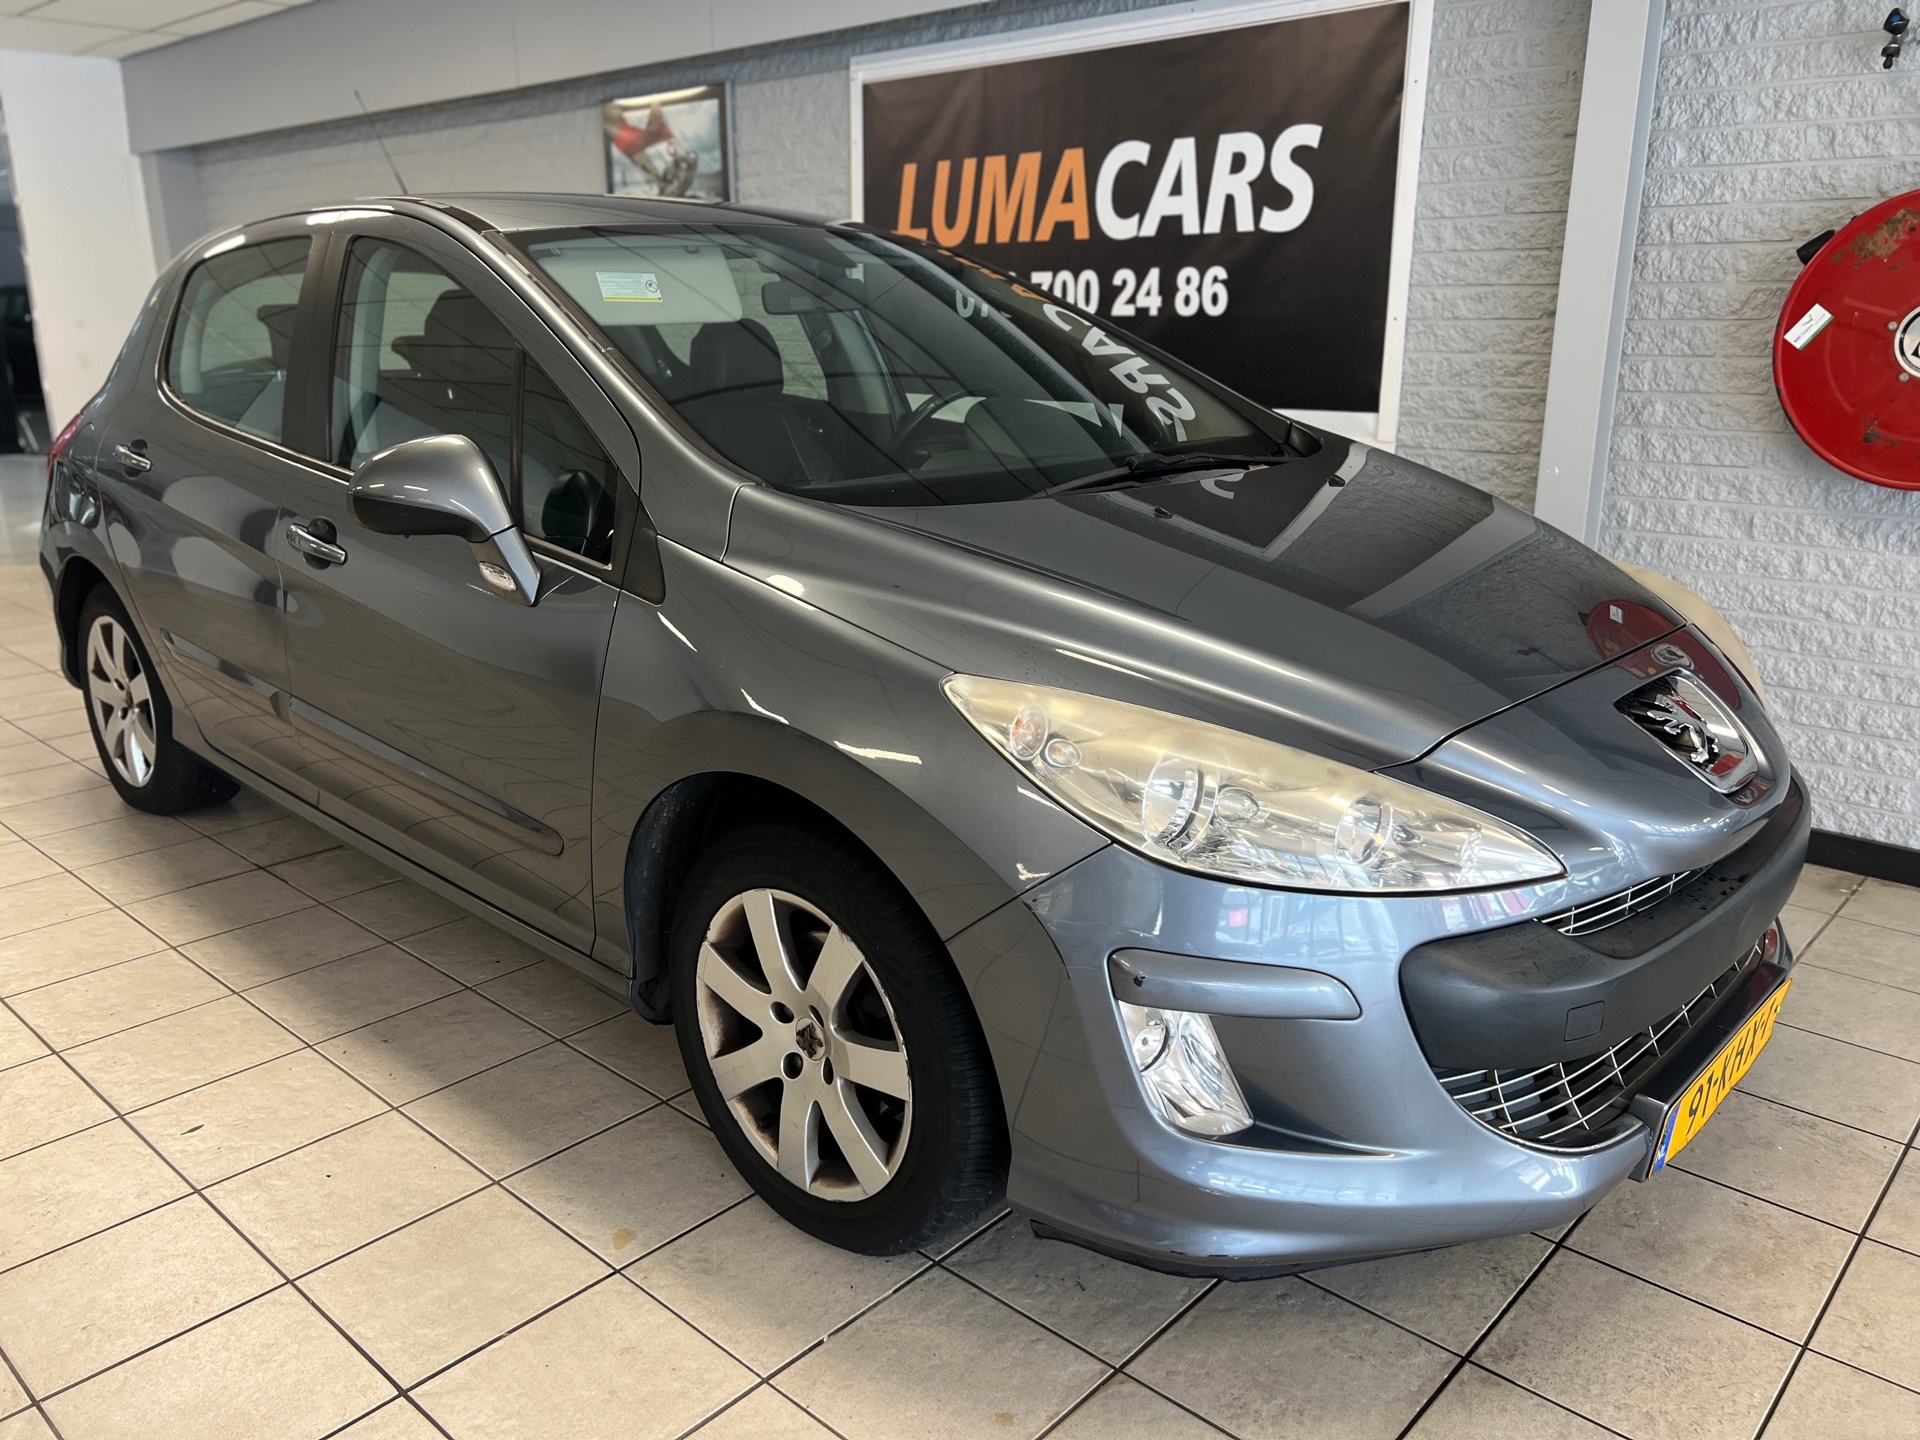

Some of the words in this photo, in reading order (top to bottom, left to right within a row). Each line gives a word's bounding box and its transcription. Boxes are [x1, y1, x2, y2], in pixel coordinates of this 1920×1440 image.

[896, 123, 1323, 247] LUMACARS
[1031, 268, 1099, 315] 700
[1110, 267, 1162, 317] 24
[1174, 265, 1229, 317] 86
